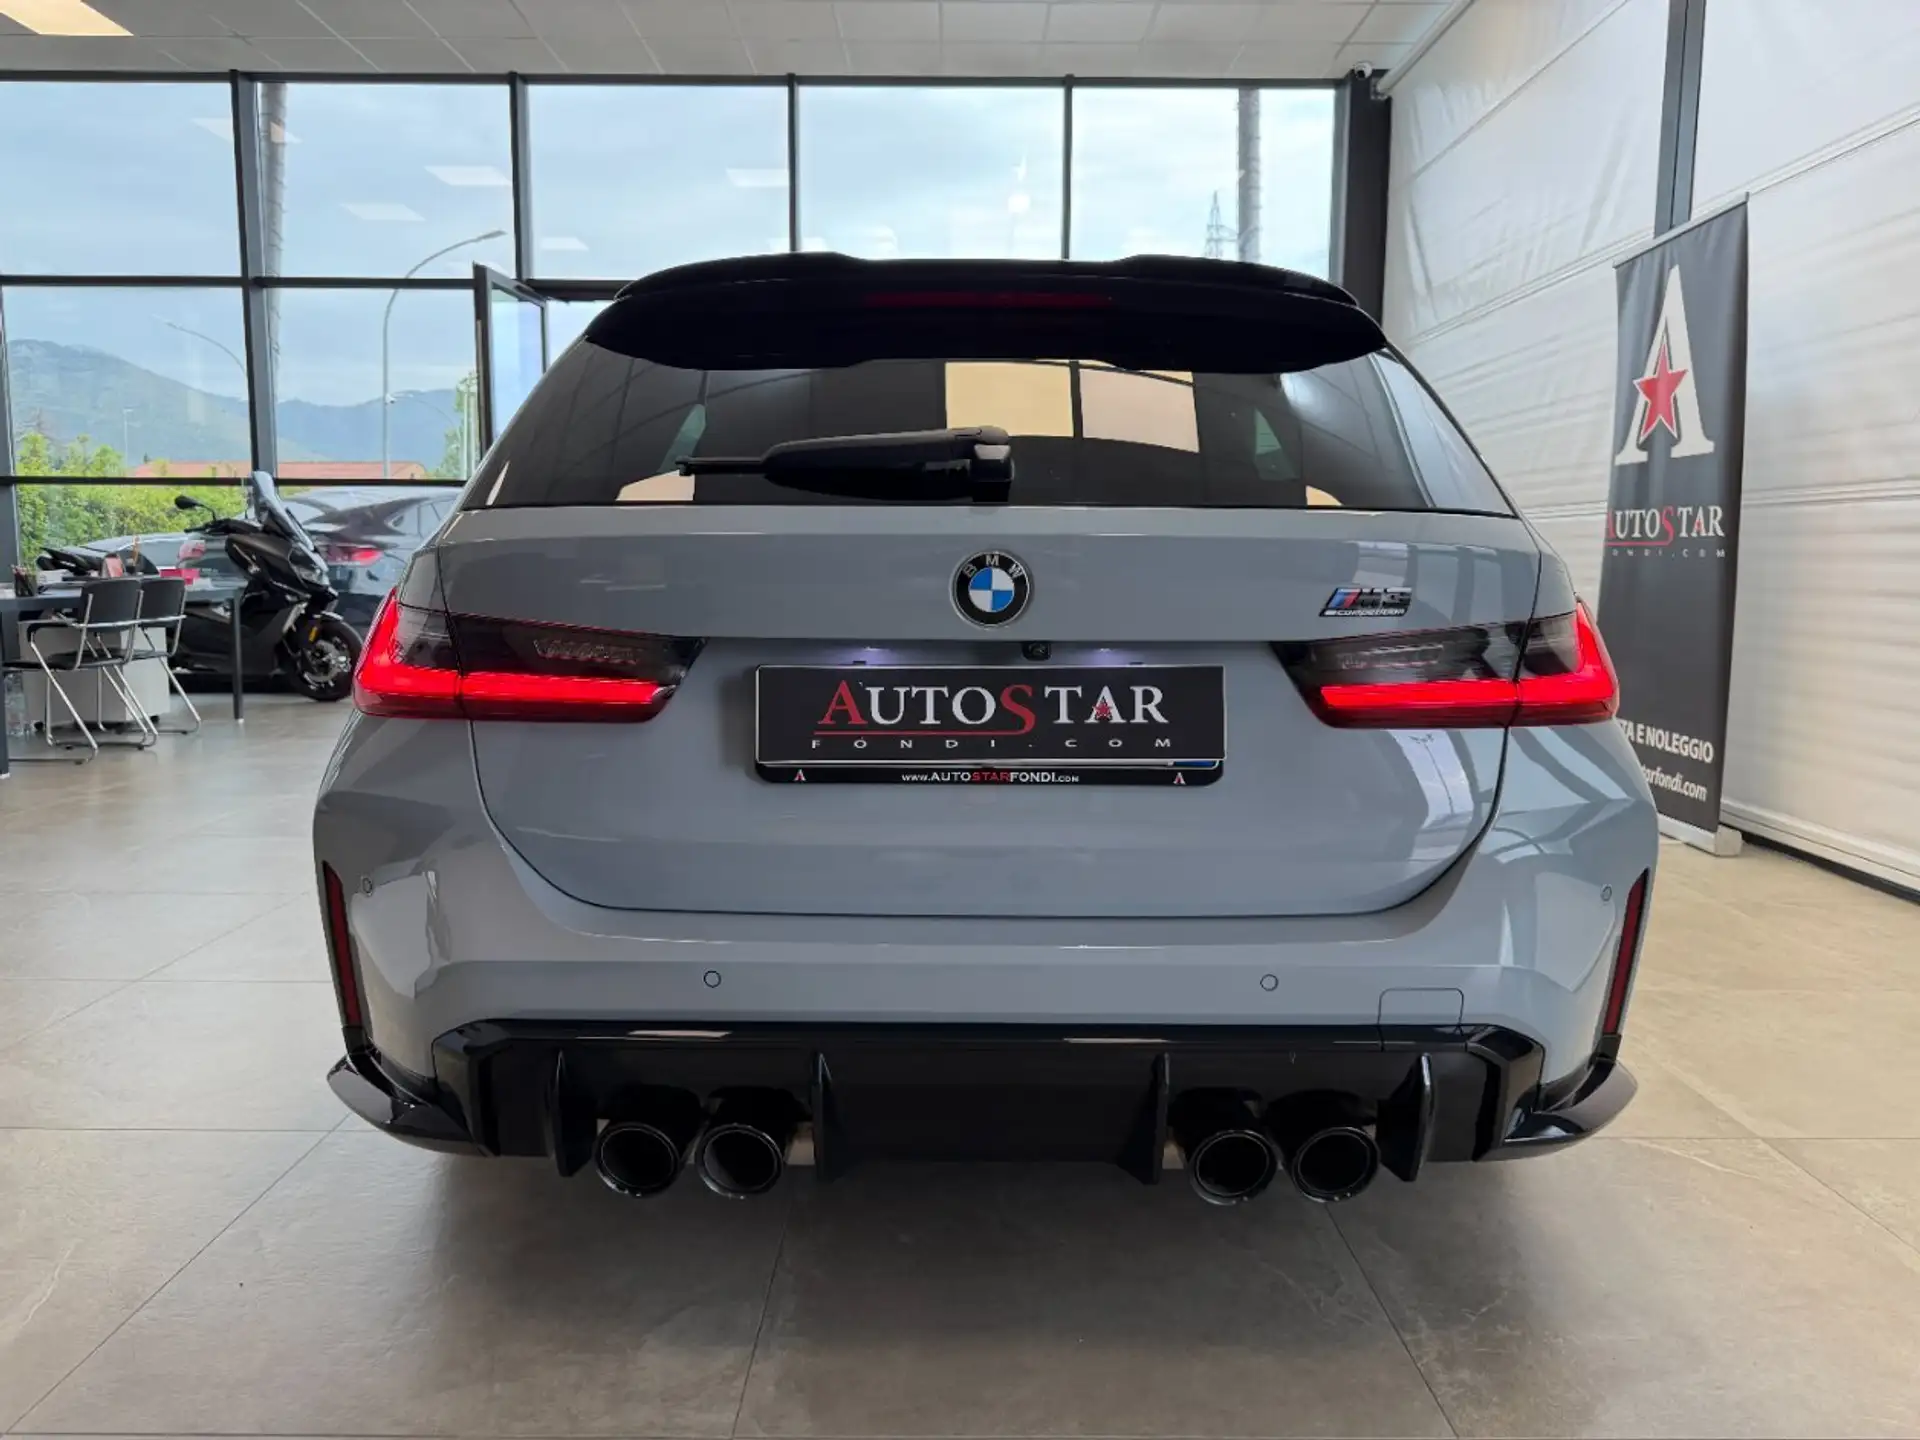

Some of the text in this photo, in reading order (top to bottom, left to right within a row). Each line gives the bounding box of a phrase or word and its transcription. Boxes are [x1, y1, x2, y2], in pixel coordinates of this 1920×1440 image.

[963, 554, 1025, 579] BMW
[1636, 723, 1645, 745] E
[1645, 725, 1714, 764] NOLEGGIO
